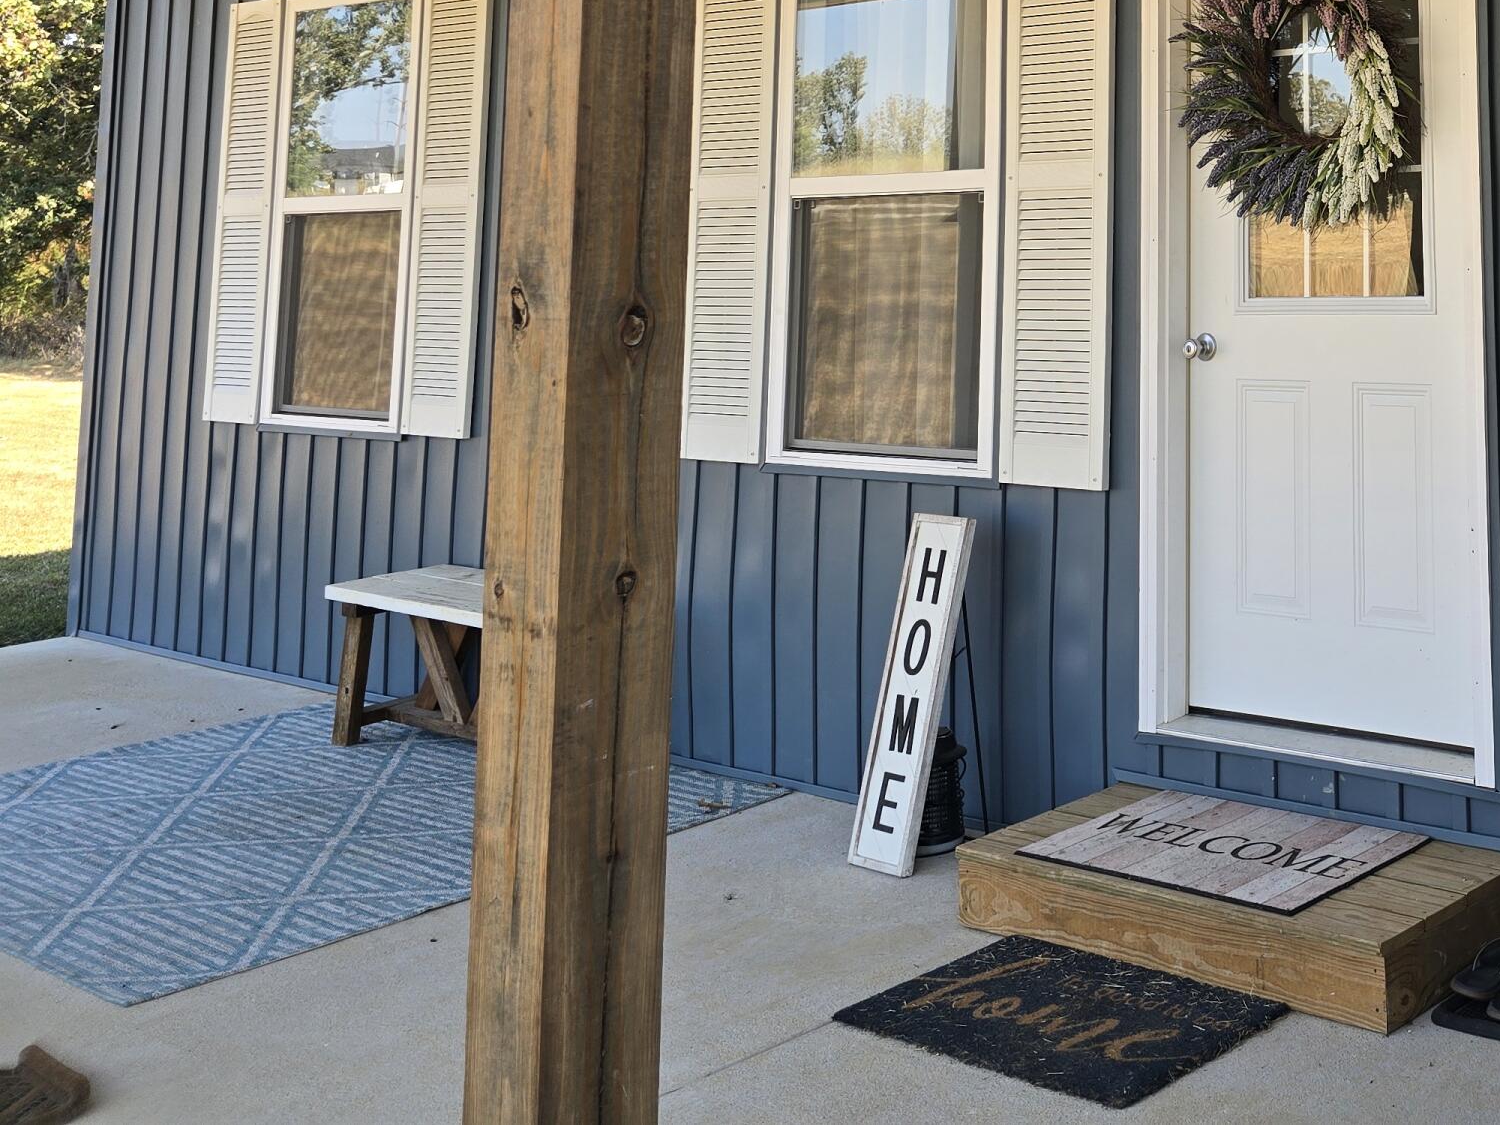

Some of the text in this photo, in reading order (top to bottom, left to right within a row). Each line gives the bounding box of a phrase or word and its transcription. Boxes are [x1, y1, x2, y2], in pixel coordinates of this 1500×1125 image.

[872, 547, 947, 834] HOME
[1096, 812, 1369, 879] WELCOME
[901, 955, 1200, 1062] home
